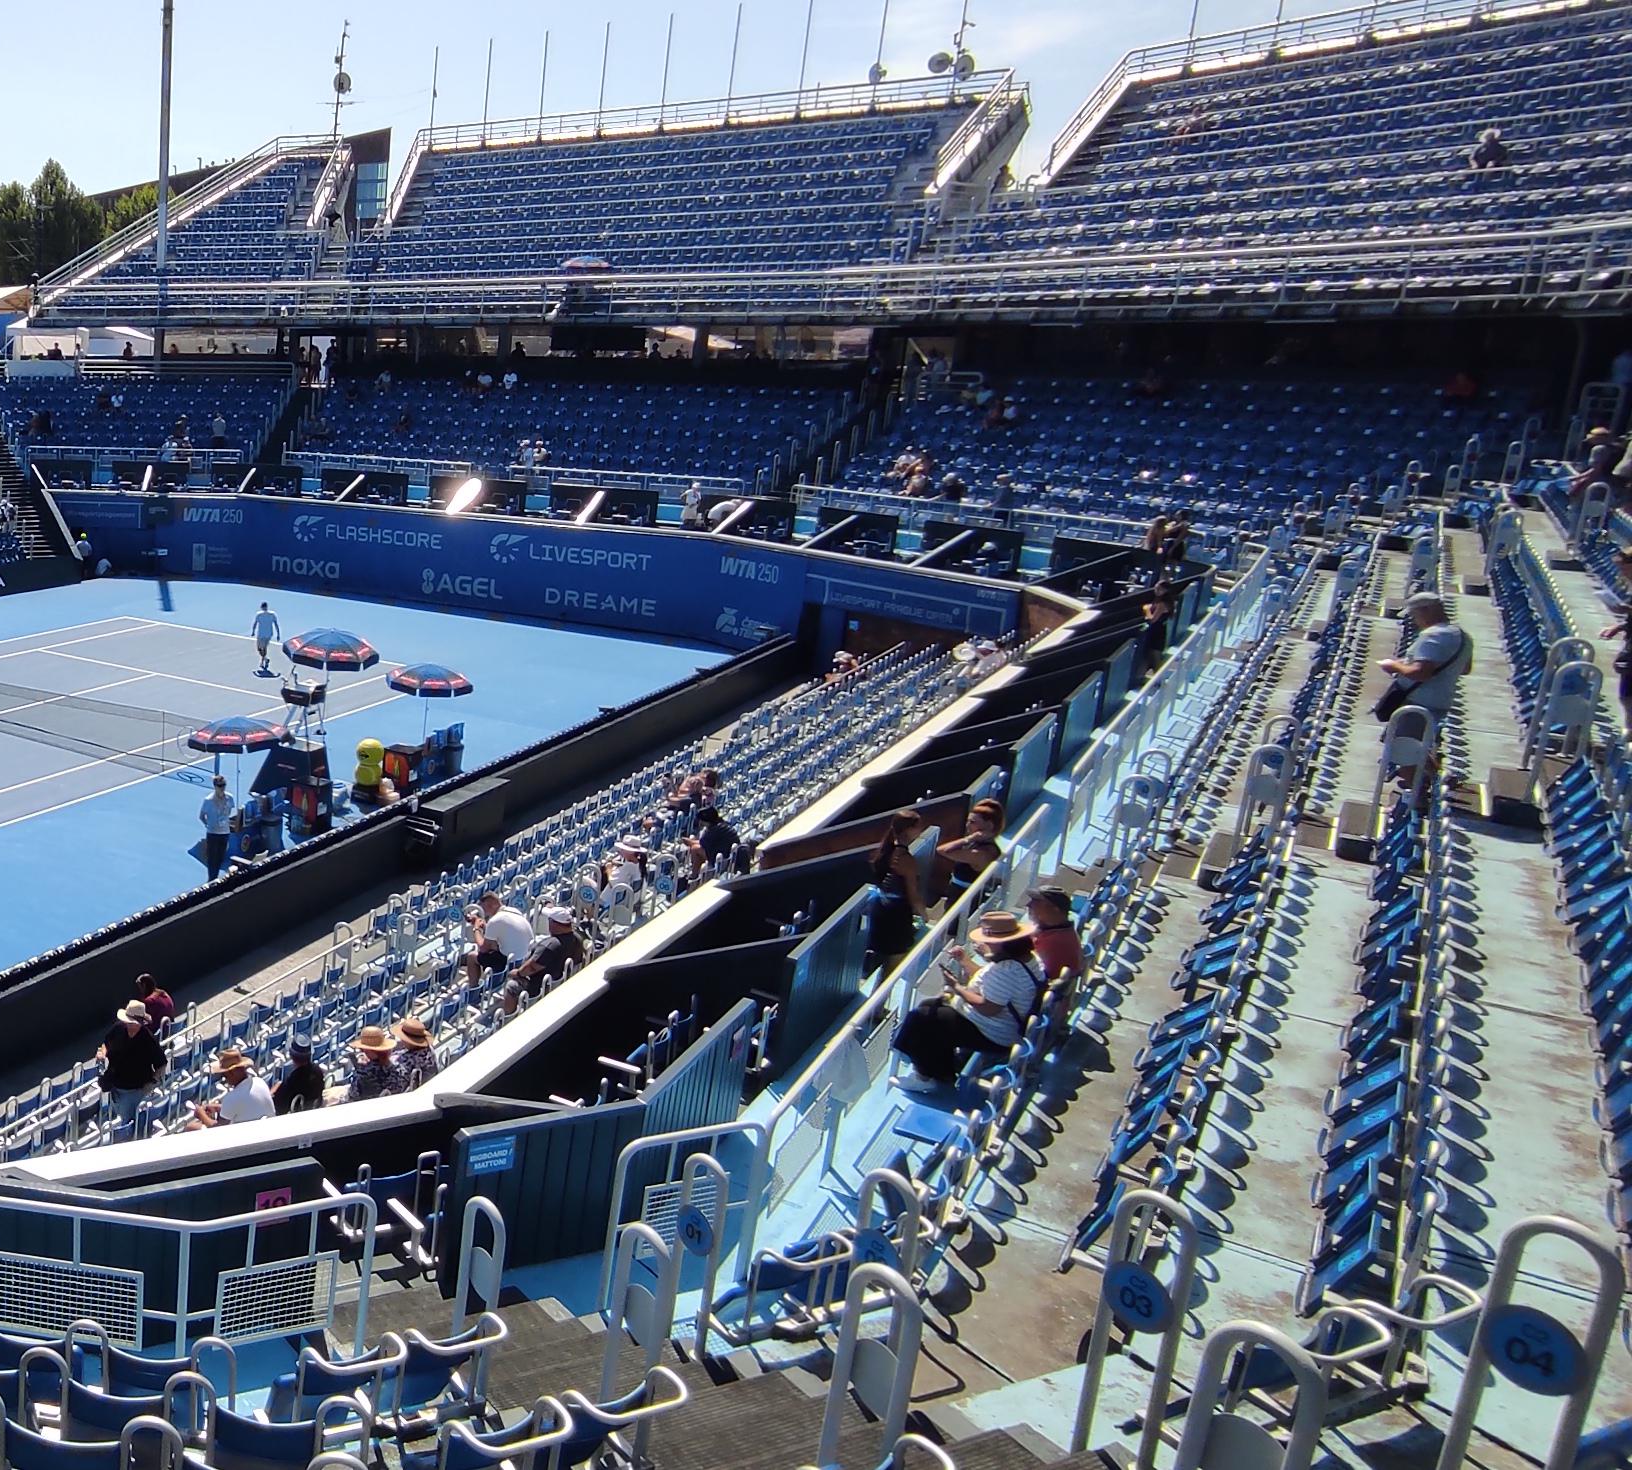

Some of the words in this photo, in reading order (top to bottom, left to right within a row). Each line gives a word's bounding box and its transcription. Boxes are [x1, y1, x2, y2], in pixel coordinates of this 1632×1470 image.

[183, 507, 220, 522] WTA
[222, 508, 243, 524] 250
[325, 524, 443, 550] FLASHSCORE
[271, 554, 341, 580] maxa
[529, 543, 653, 571] LIVESPORT
[720, 556, 756, 580] WTA
[757, 562, 780, 585] 250
[436, 572, 503, 600] AGEL
[544, 587, 657, 617] DREAME
[685, 1223, 702, 1245] 01
[1119, 1285, 1154, 1319] 03
[1504, 1336, 1556, 1378] 04
